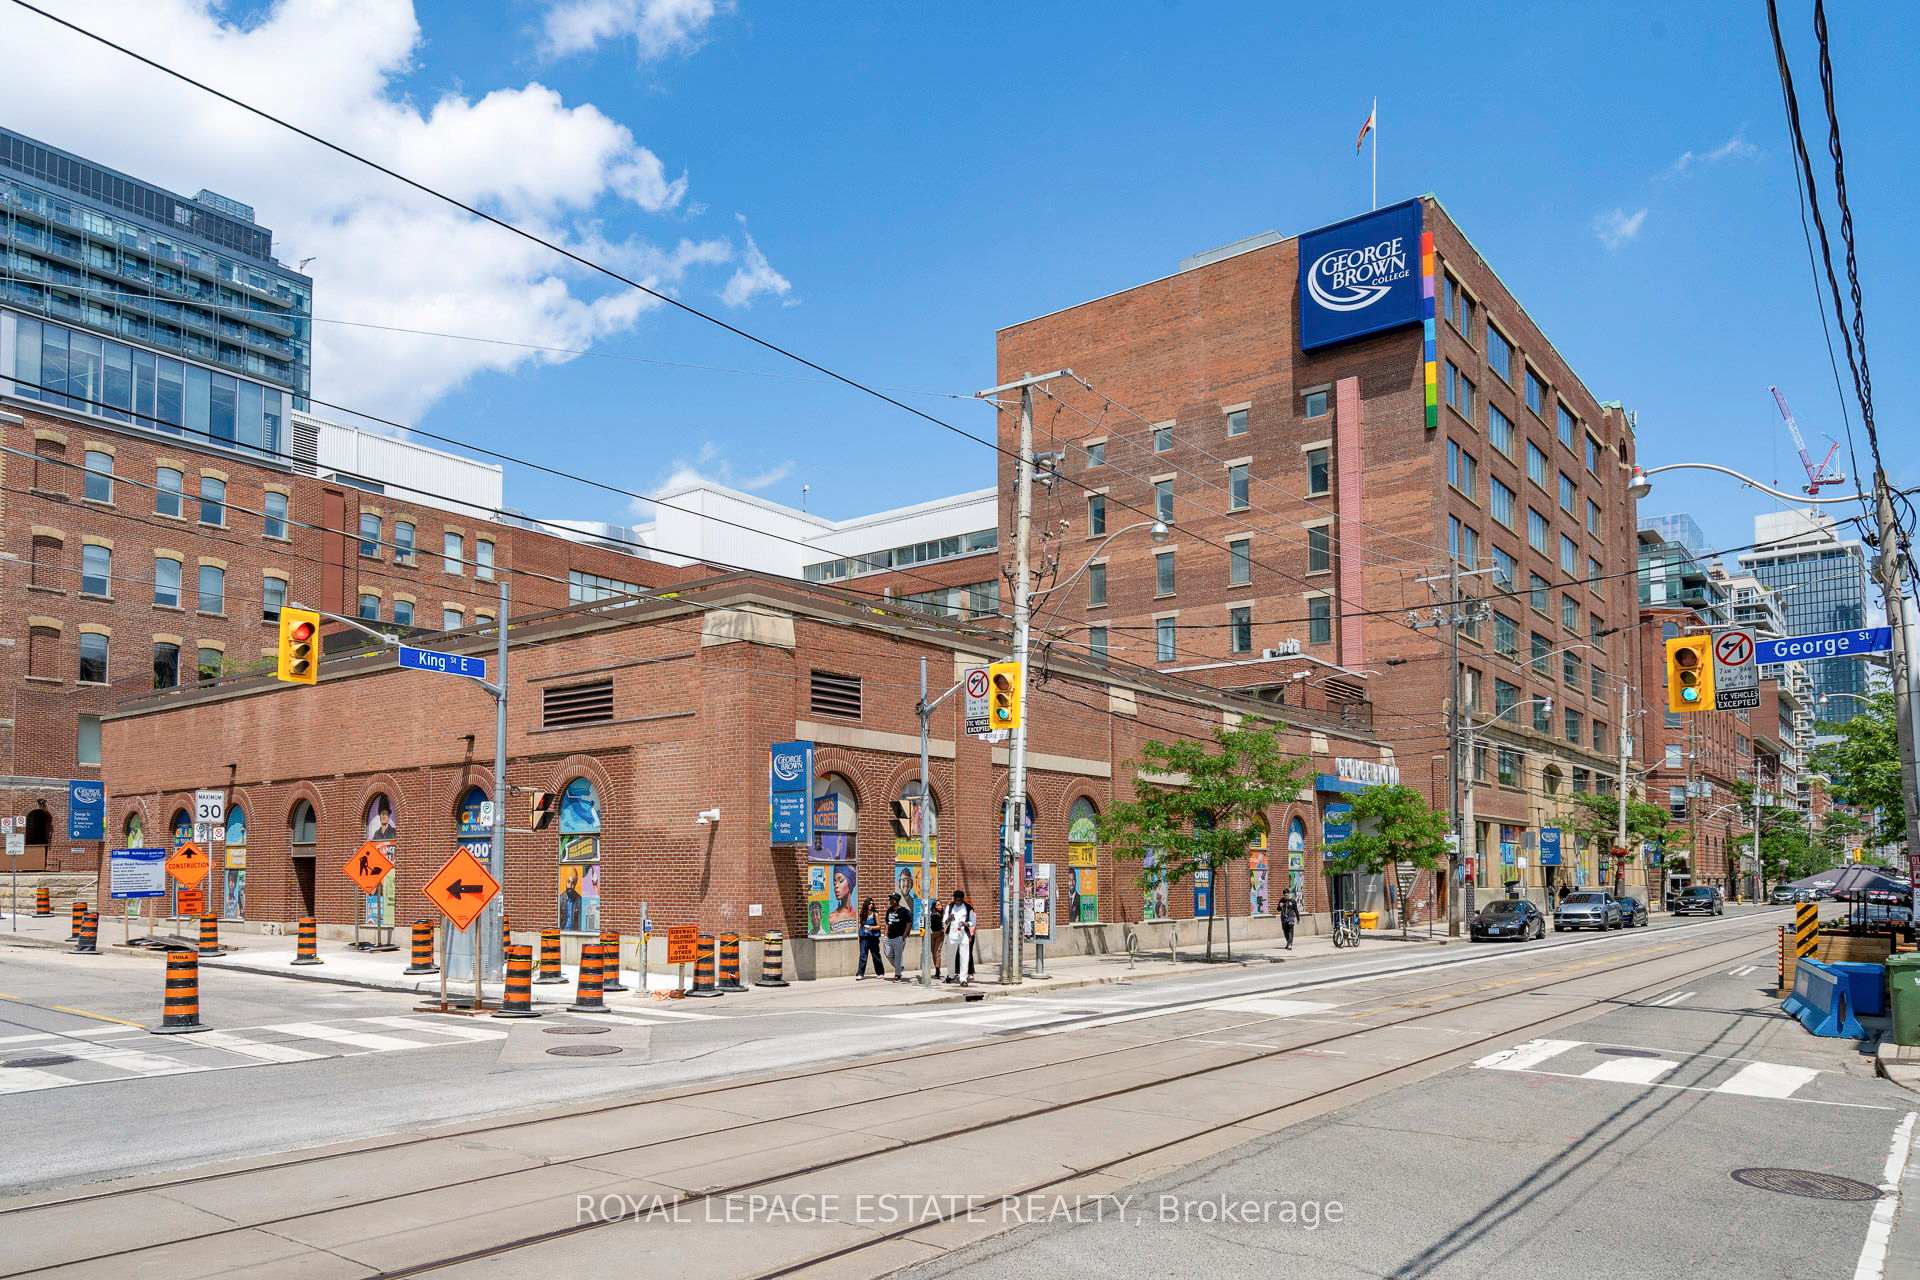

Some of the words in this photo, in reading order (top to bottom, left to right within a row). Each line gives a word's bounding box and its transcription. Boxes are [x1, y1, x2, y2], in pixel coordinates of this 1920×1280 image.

[1321, 237, 1403, 276] GEORGE
[1332, 253, 1406, 290] BROWN
[1371, 269, 1410, 286] COLLEGE
[1774, 637, 1849, 657] George
[419, 651, 446, 671] King
[449, 656, 457, 665] St
[460, 658, 469, 672] E
[1730, 689, 1759, 700] VEHICLES
[1718, 698, 1758, 709] EXCEPTED
[779, 755, 802, 763] GEORGE
[780, 762, 803, 771] BROWN
[198, 793, 222, 801] MAXIMUM
[199, 804, 221, 819] 30
[1194, 870, 1209, 880] ONE
